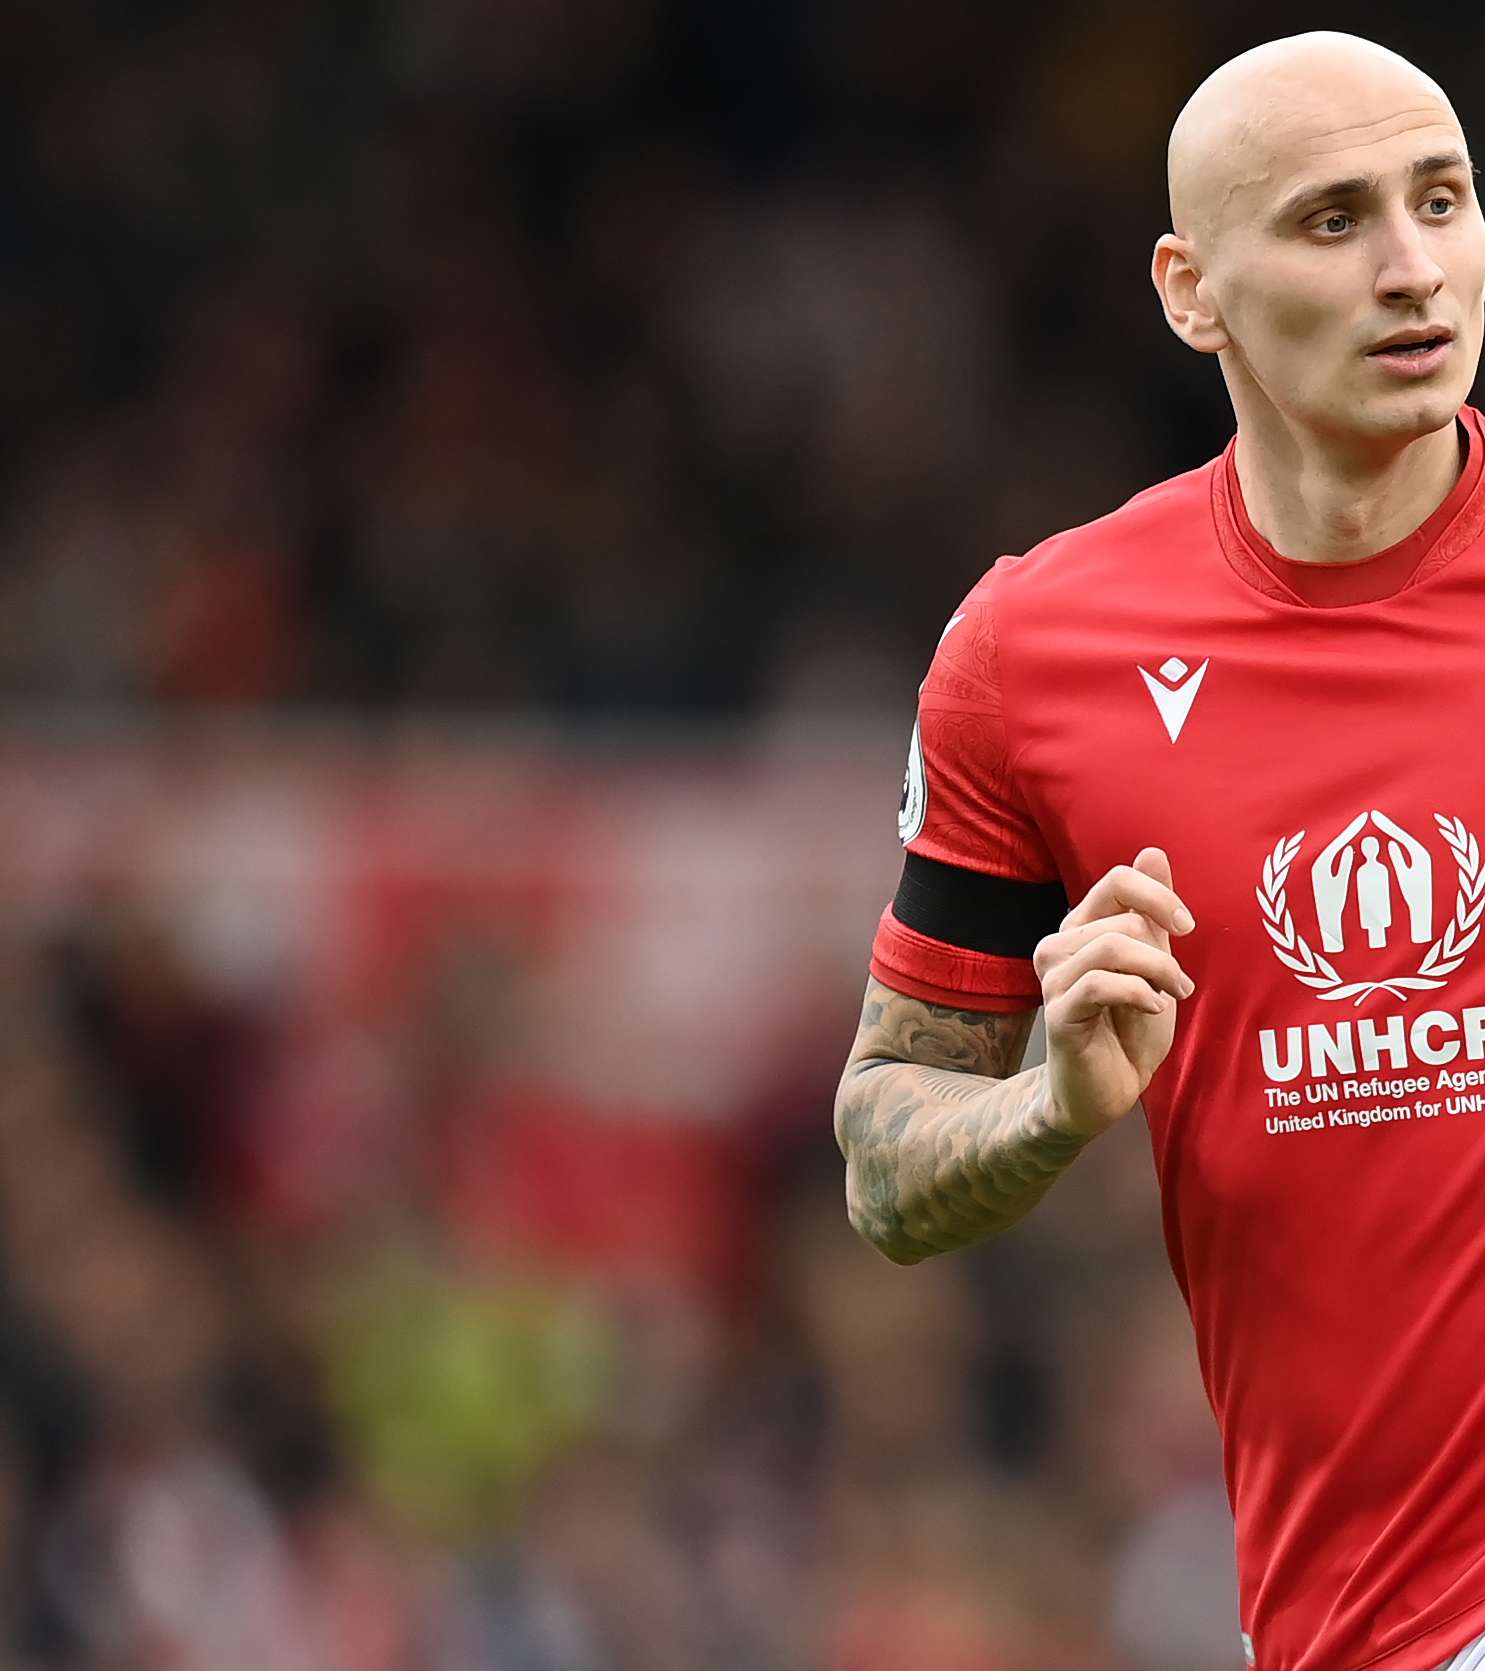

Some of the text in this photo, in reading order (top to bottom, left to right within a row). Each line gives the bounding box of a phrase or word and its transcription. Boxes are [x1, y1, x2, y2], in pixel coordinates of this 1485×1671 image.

[1263, 1088, 1301, 1108] The
[1305, 1082, 1339, 1104] UN
[1343, 1077, 1430, 1099] Refugee
[1265, 1112, 1325, 1135] United
[1328, 1105, 1411, 1127] Kingdom
[1414, 1101, 1442, 1118] for
